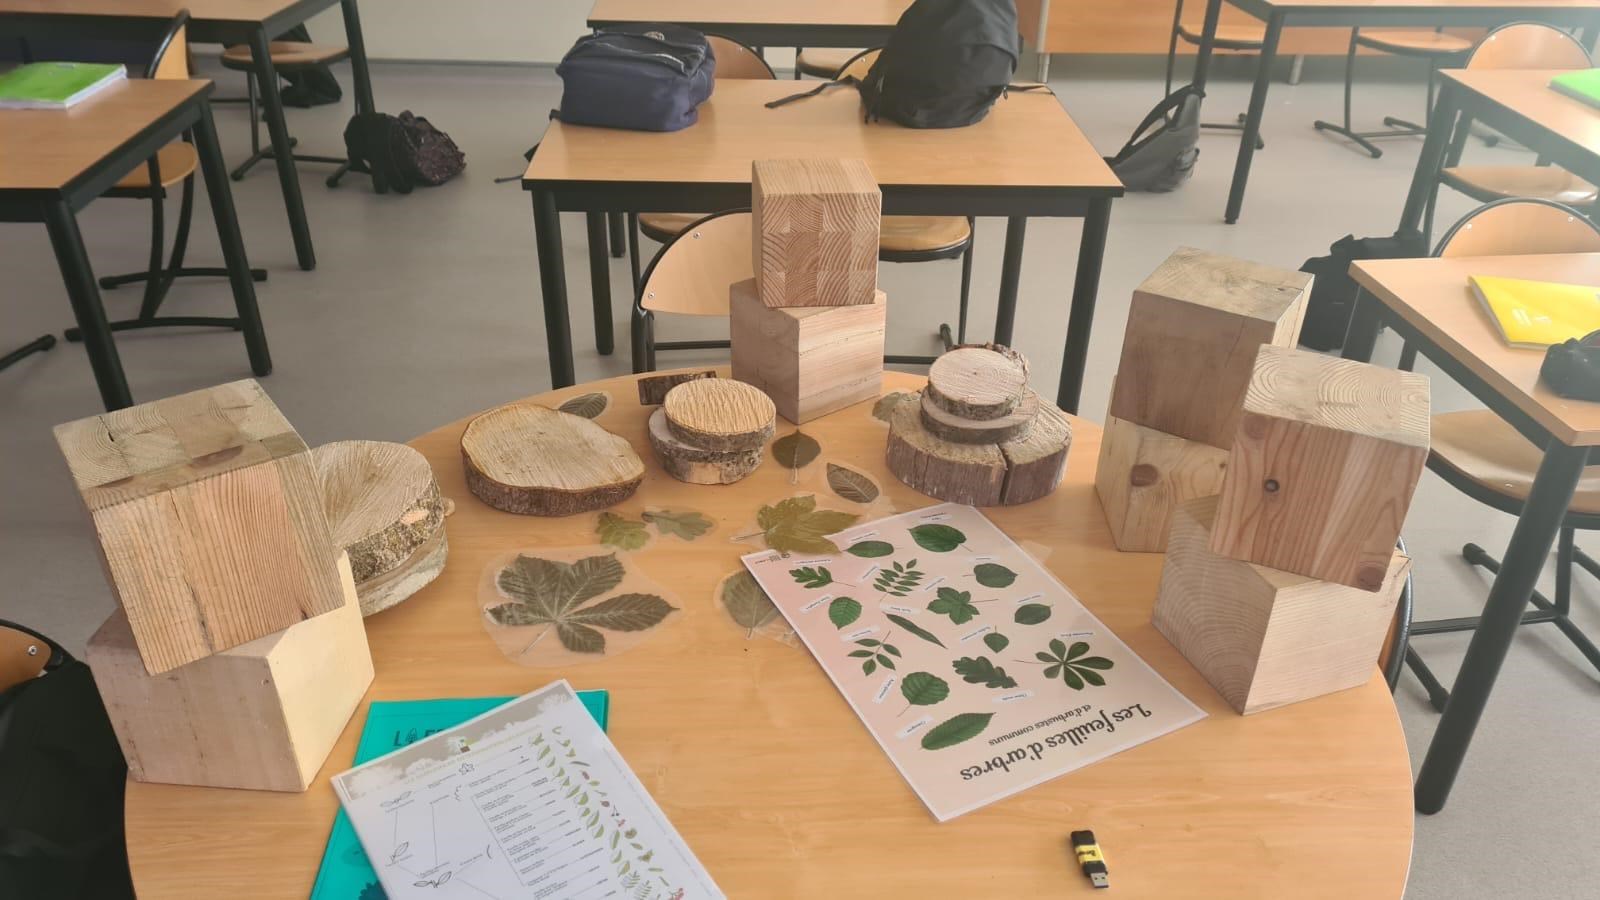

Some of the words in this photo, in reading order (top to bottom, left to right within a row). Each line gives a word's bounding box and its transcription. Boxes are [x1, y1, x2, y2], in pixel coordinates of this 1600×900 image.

[1034, 708, 1082, 729] d'arbustes
[1081, 704, 1092, 713] et
[1112, 703, 1152, 722] Les
[988, 725, 1034, 746] communs
[1045, 710, 1115, 748] feuilles
[960, 742, 1043, 780] d'arbres
